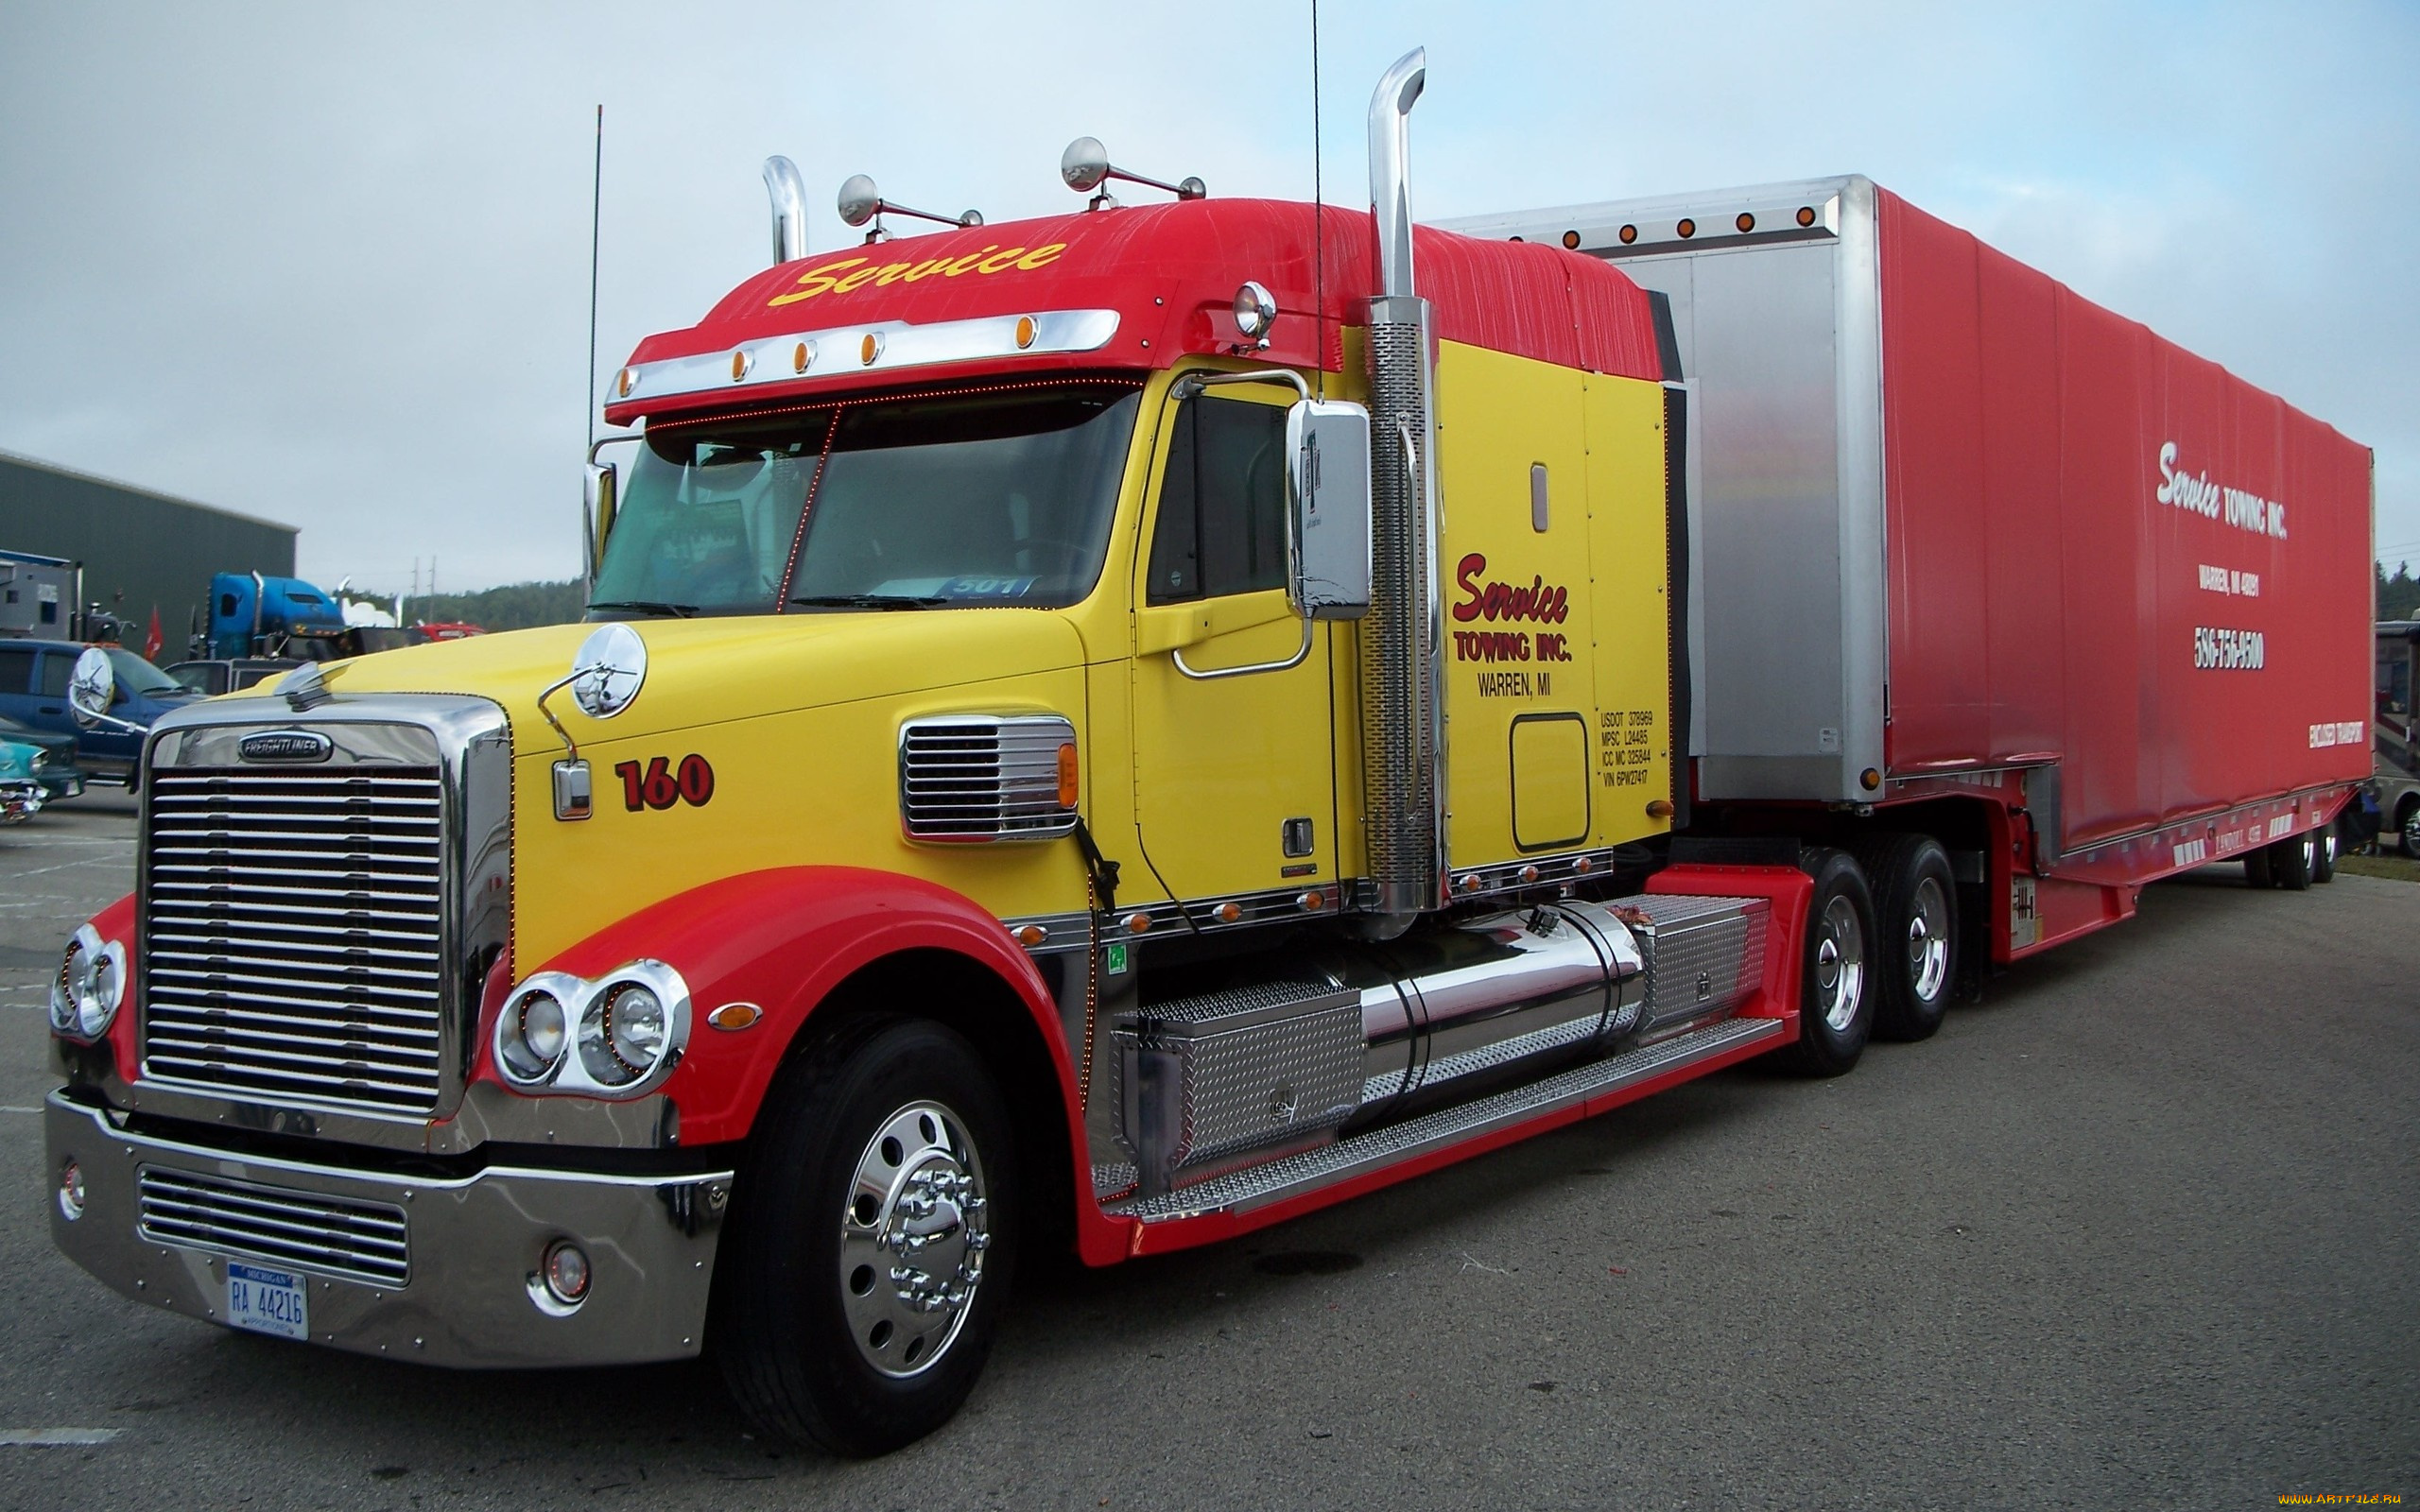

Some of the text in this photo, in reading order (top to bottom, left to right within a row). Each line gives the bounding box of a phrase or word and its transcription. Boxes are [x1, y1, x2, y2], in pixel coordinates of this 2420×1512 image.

[767, 243, 1067, 307] Service
[2156, 441, 2288, 541] Service TOWING INC.
[953, 578, 1019, 594] 501
[1453, 553, 1569, 625] Service
[1453, 631, 1572, 663] TOWING INC.
[1478, 672, 1550, 701] WARREN, MI
[1600, 712, 1624, 728] USDOT
[245, 739, 318, 752] FREIGHTLINER
[1601, 730, 1620, 747] MPSC
[1602, 750, 1614, 766] ICC
[1616, 749, 1625, 765] MC
[614, 753, 715, 813] 160
[1603, 772, 1615, 787] VIN
[247, 1268, 286, 1284] MICHIGAN
[232, 1281, 302, 1324] RA 44216
